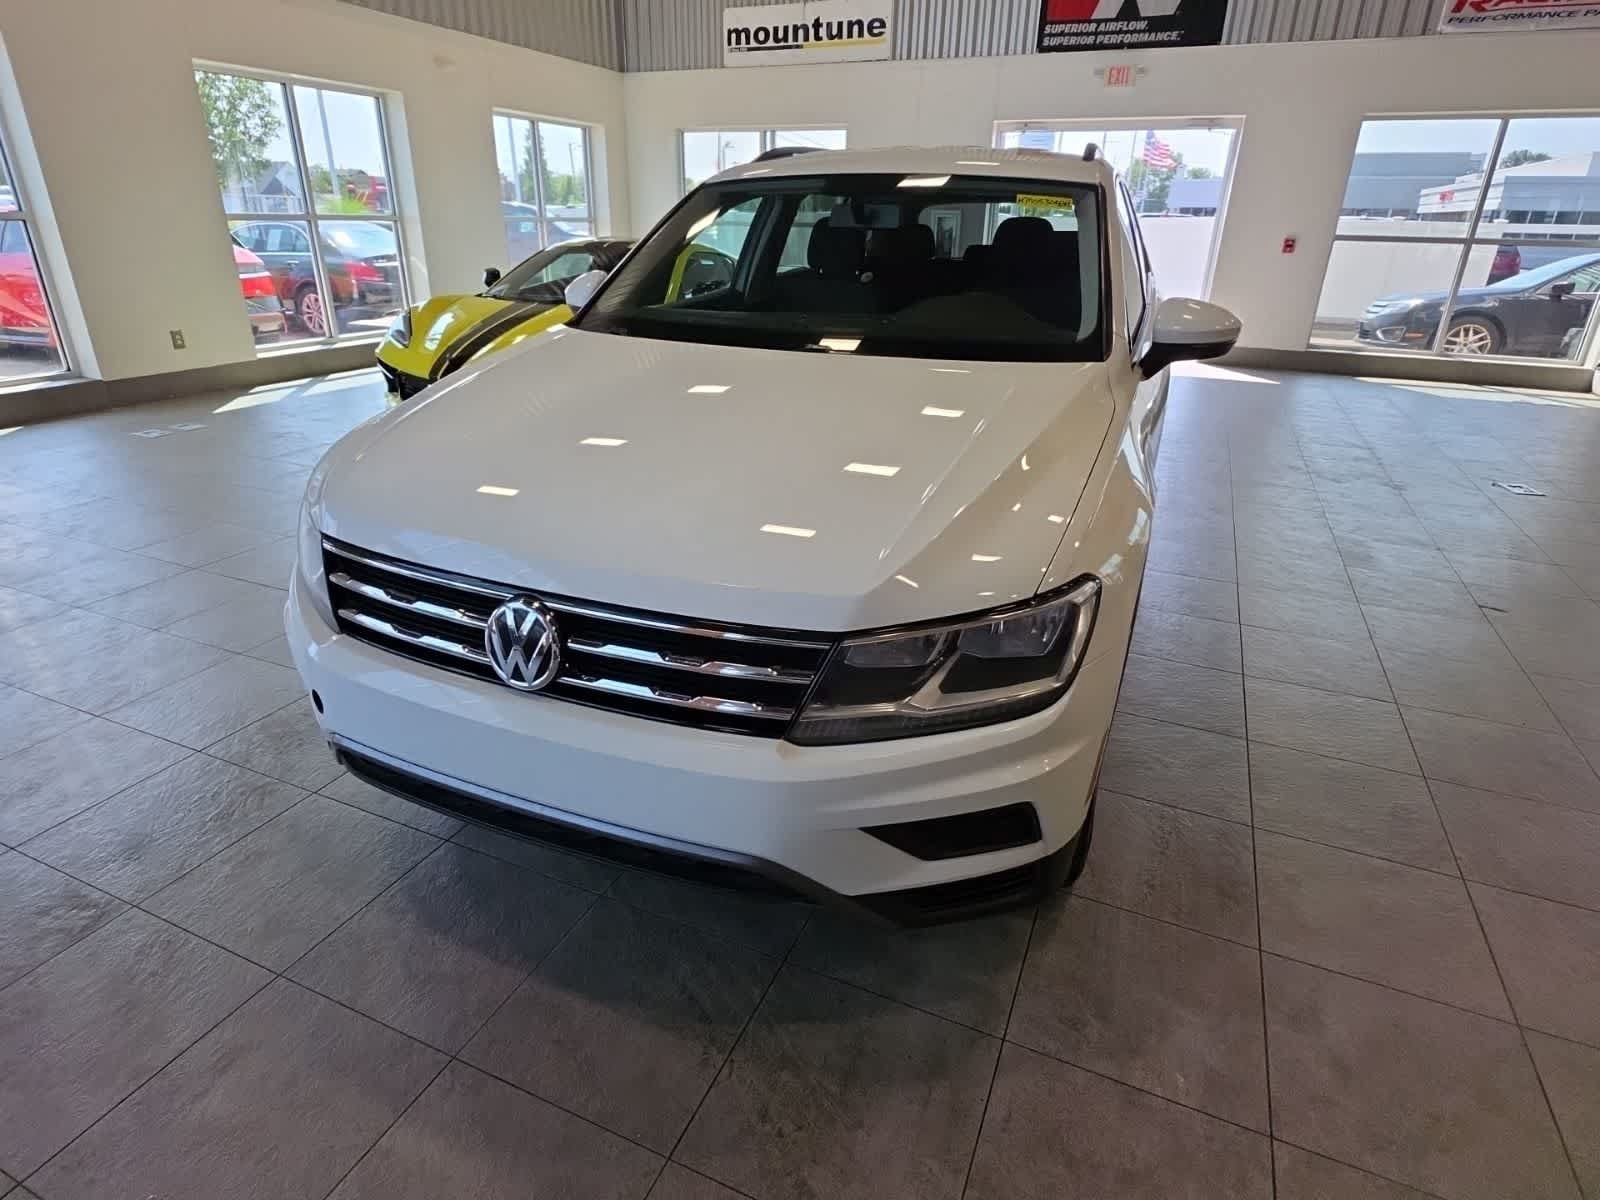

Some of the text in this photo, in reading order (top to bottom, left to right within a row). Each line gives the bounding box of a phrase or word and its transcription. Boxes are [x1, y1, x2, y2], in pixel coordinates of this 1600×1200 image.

[1447, 10, 1577, 24] PERFORMANCE
[727, 16, 887, 46] mountune
[1044, 20, 1149, 34] SUPERIOR AIRFLOW.
[1042, 34, 1096, 46] SUPERIOR
